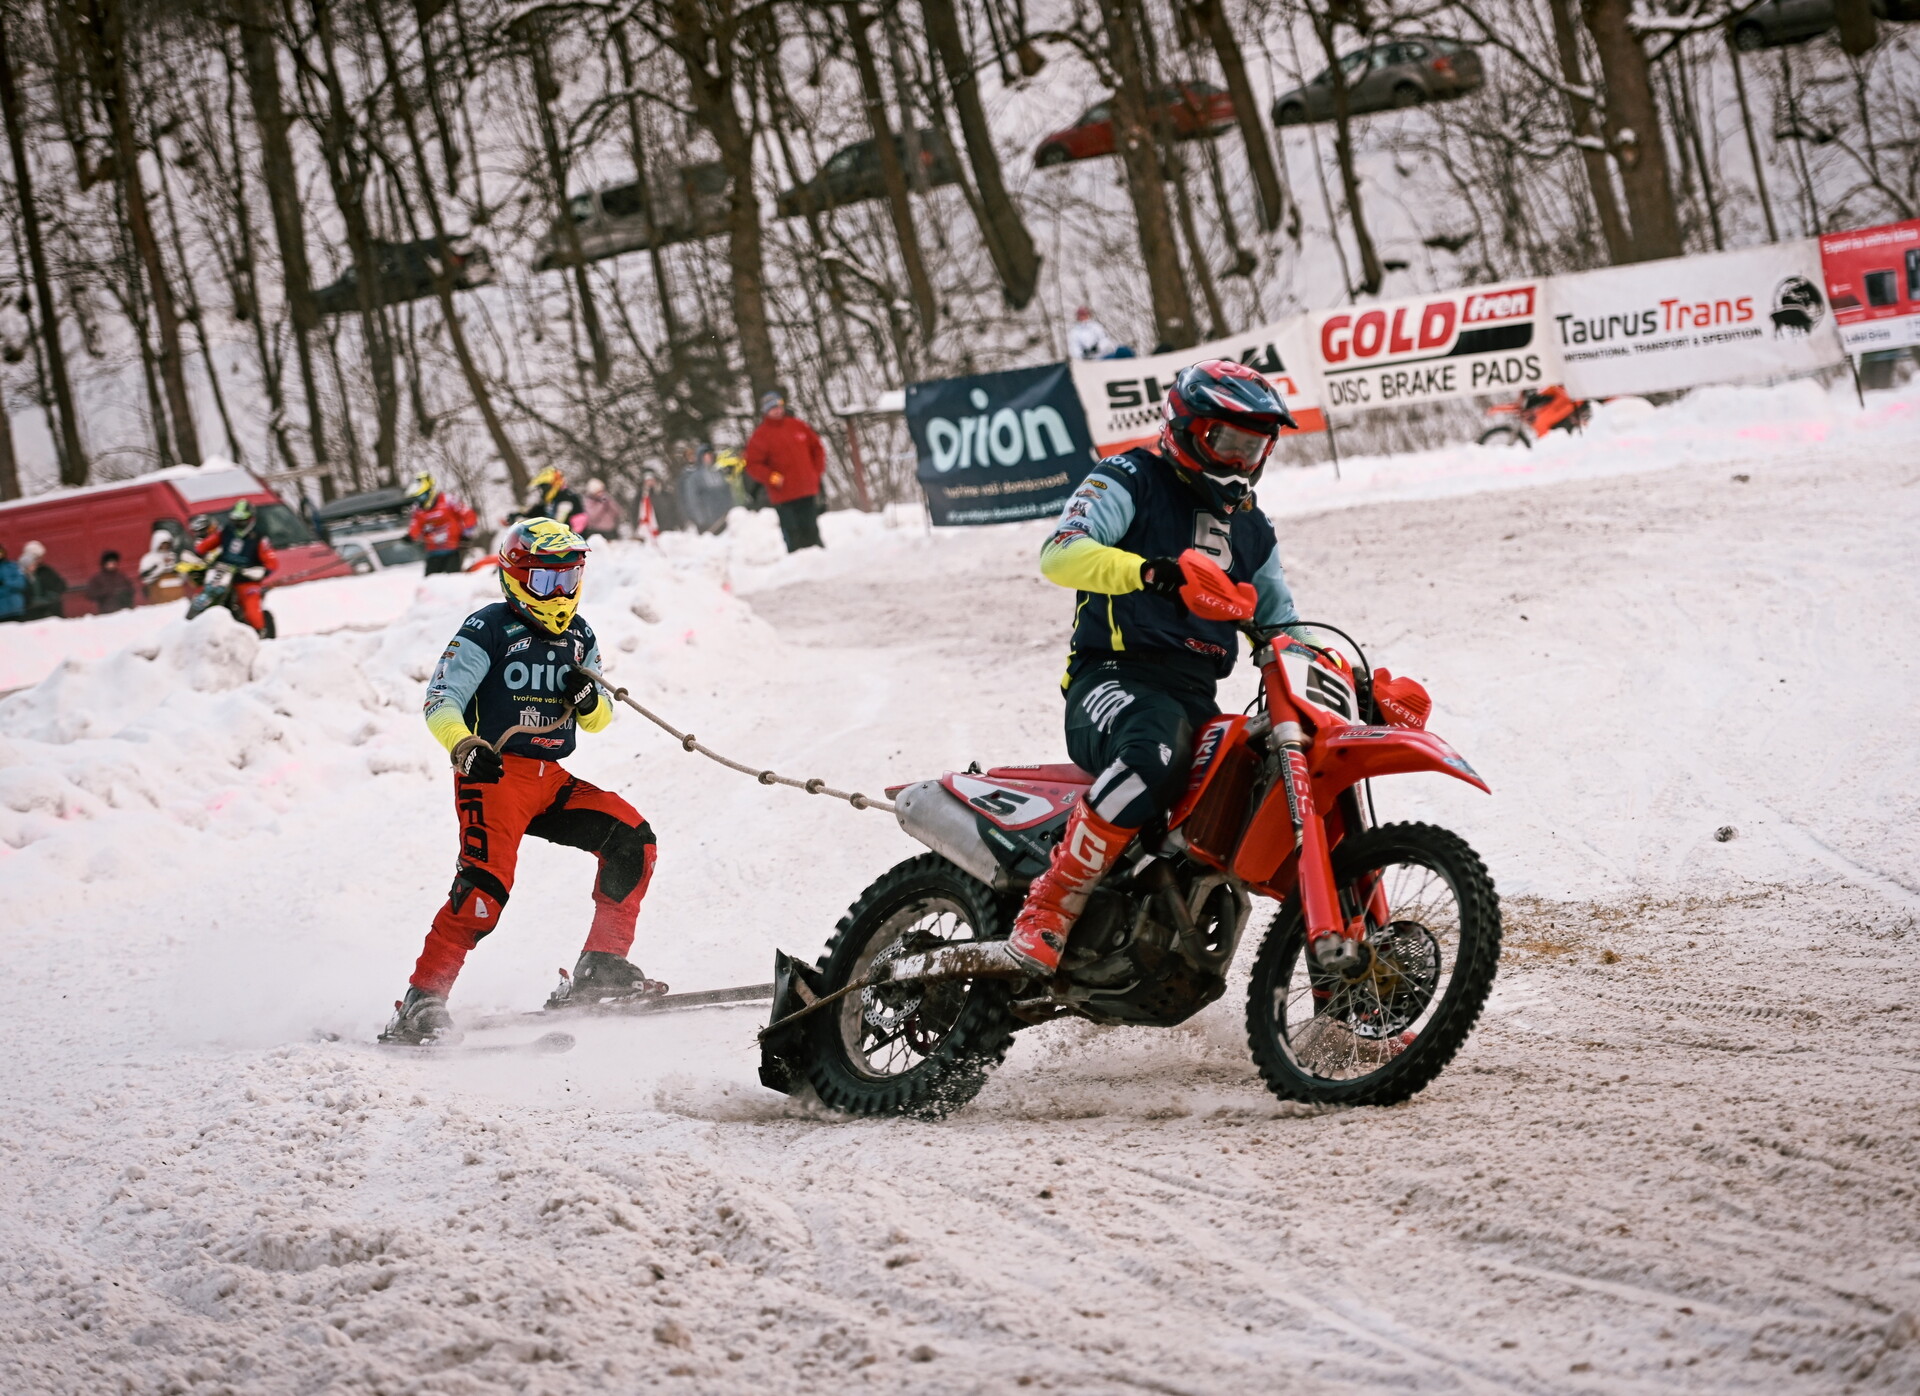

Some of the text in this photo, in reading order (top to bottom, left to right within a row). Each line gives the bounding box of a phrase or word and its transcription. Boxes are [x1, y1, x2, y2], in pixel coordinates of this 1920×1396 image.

[1468, 291, 1530, 320] fren
[1556, 297, 1754, 347] TaurusTrans
[1321, 302, 1457, 363] GOLD
[1329, 355, 1542, 406] DISC BRAKE PADS
[926, 388, 1076, 473] orion
[1194, 511, 1233, 571] 5
[1305, 664, 1352, 721] 5
[1190, 727, 1222, 770] CRF
[969, 789, 1031, 817] 5
[1070, 821, 1107, 870] G
